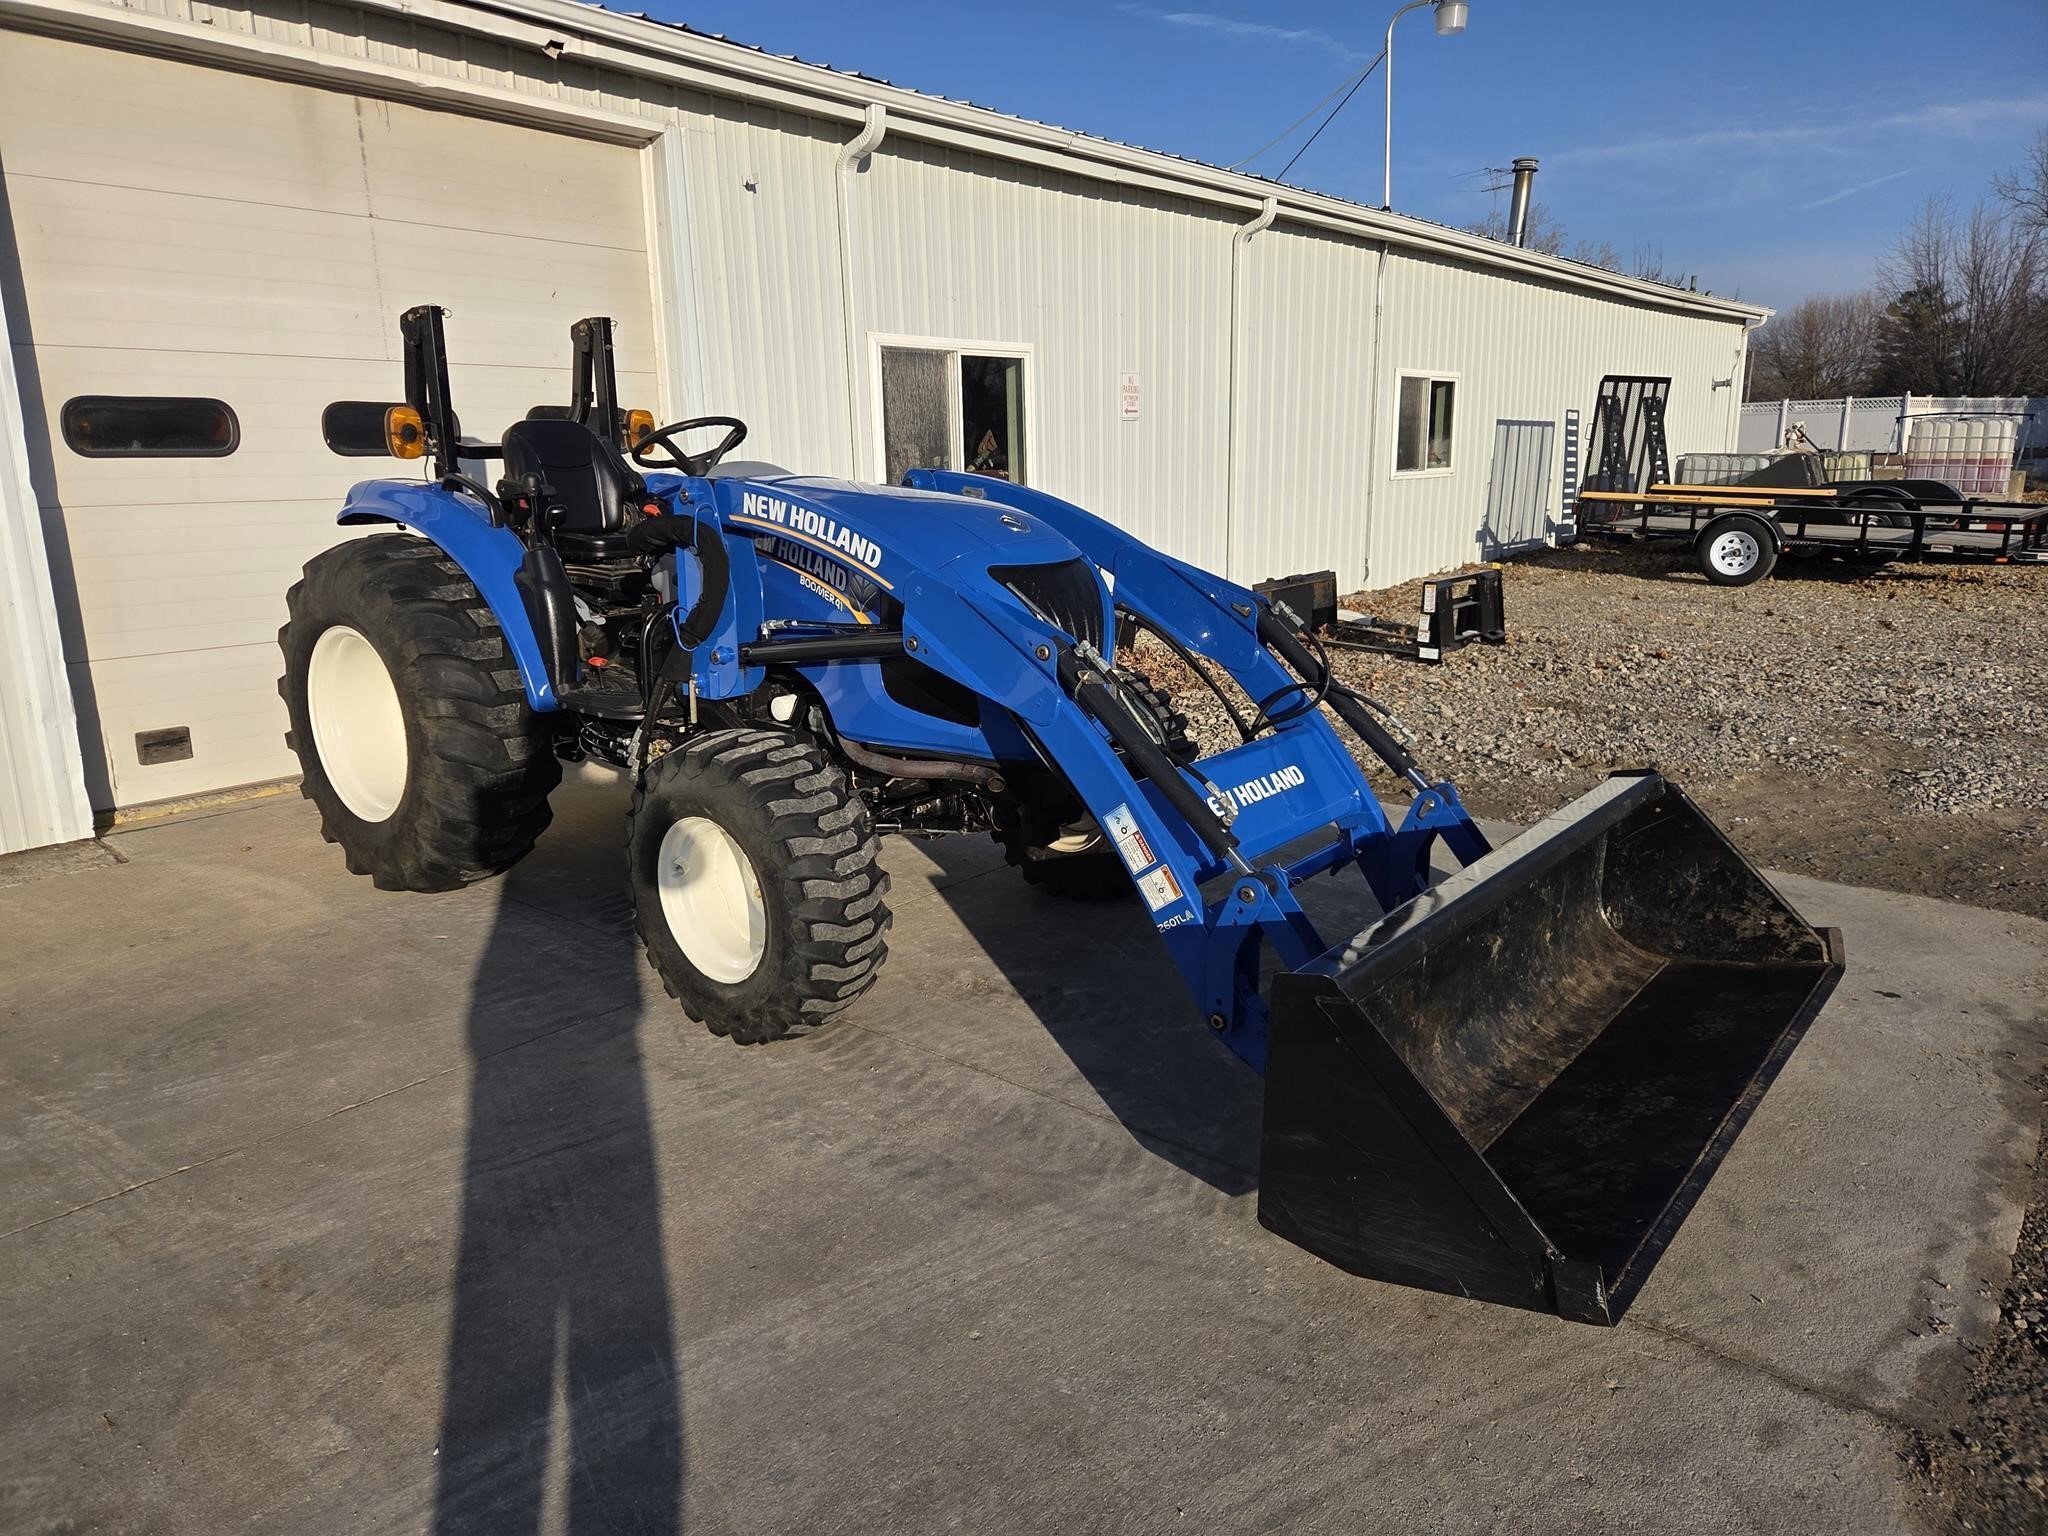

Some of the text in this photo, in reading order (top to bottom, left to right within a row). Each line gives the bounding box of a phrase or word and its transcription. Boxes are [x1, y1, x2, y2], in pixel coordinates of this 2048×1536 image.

[743, 492, 882, 569] NEW HOLLAND
[777, 539, 847, 592] HOLLAND
[800, 575, 835, 605] BOOMER
[1233, 765, 1305, 807] HOLLAND
[1156, 909, 1195, 934] 260TLA
